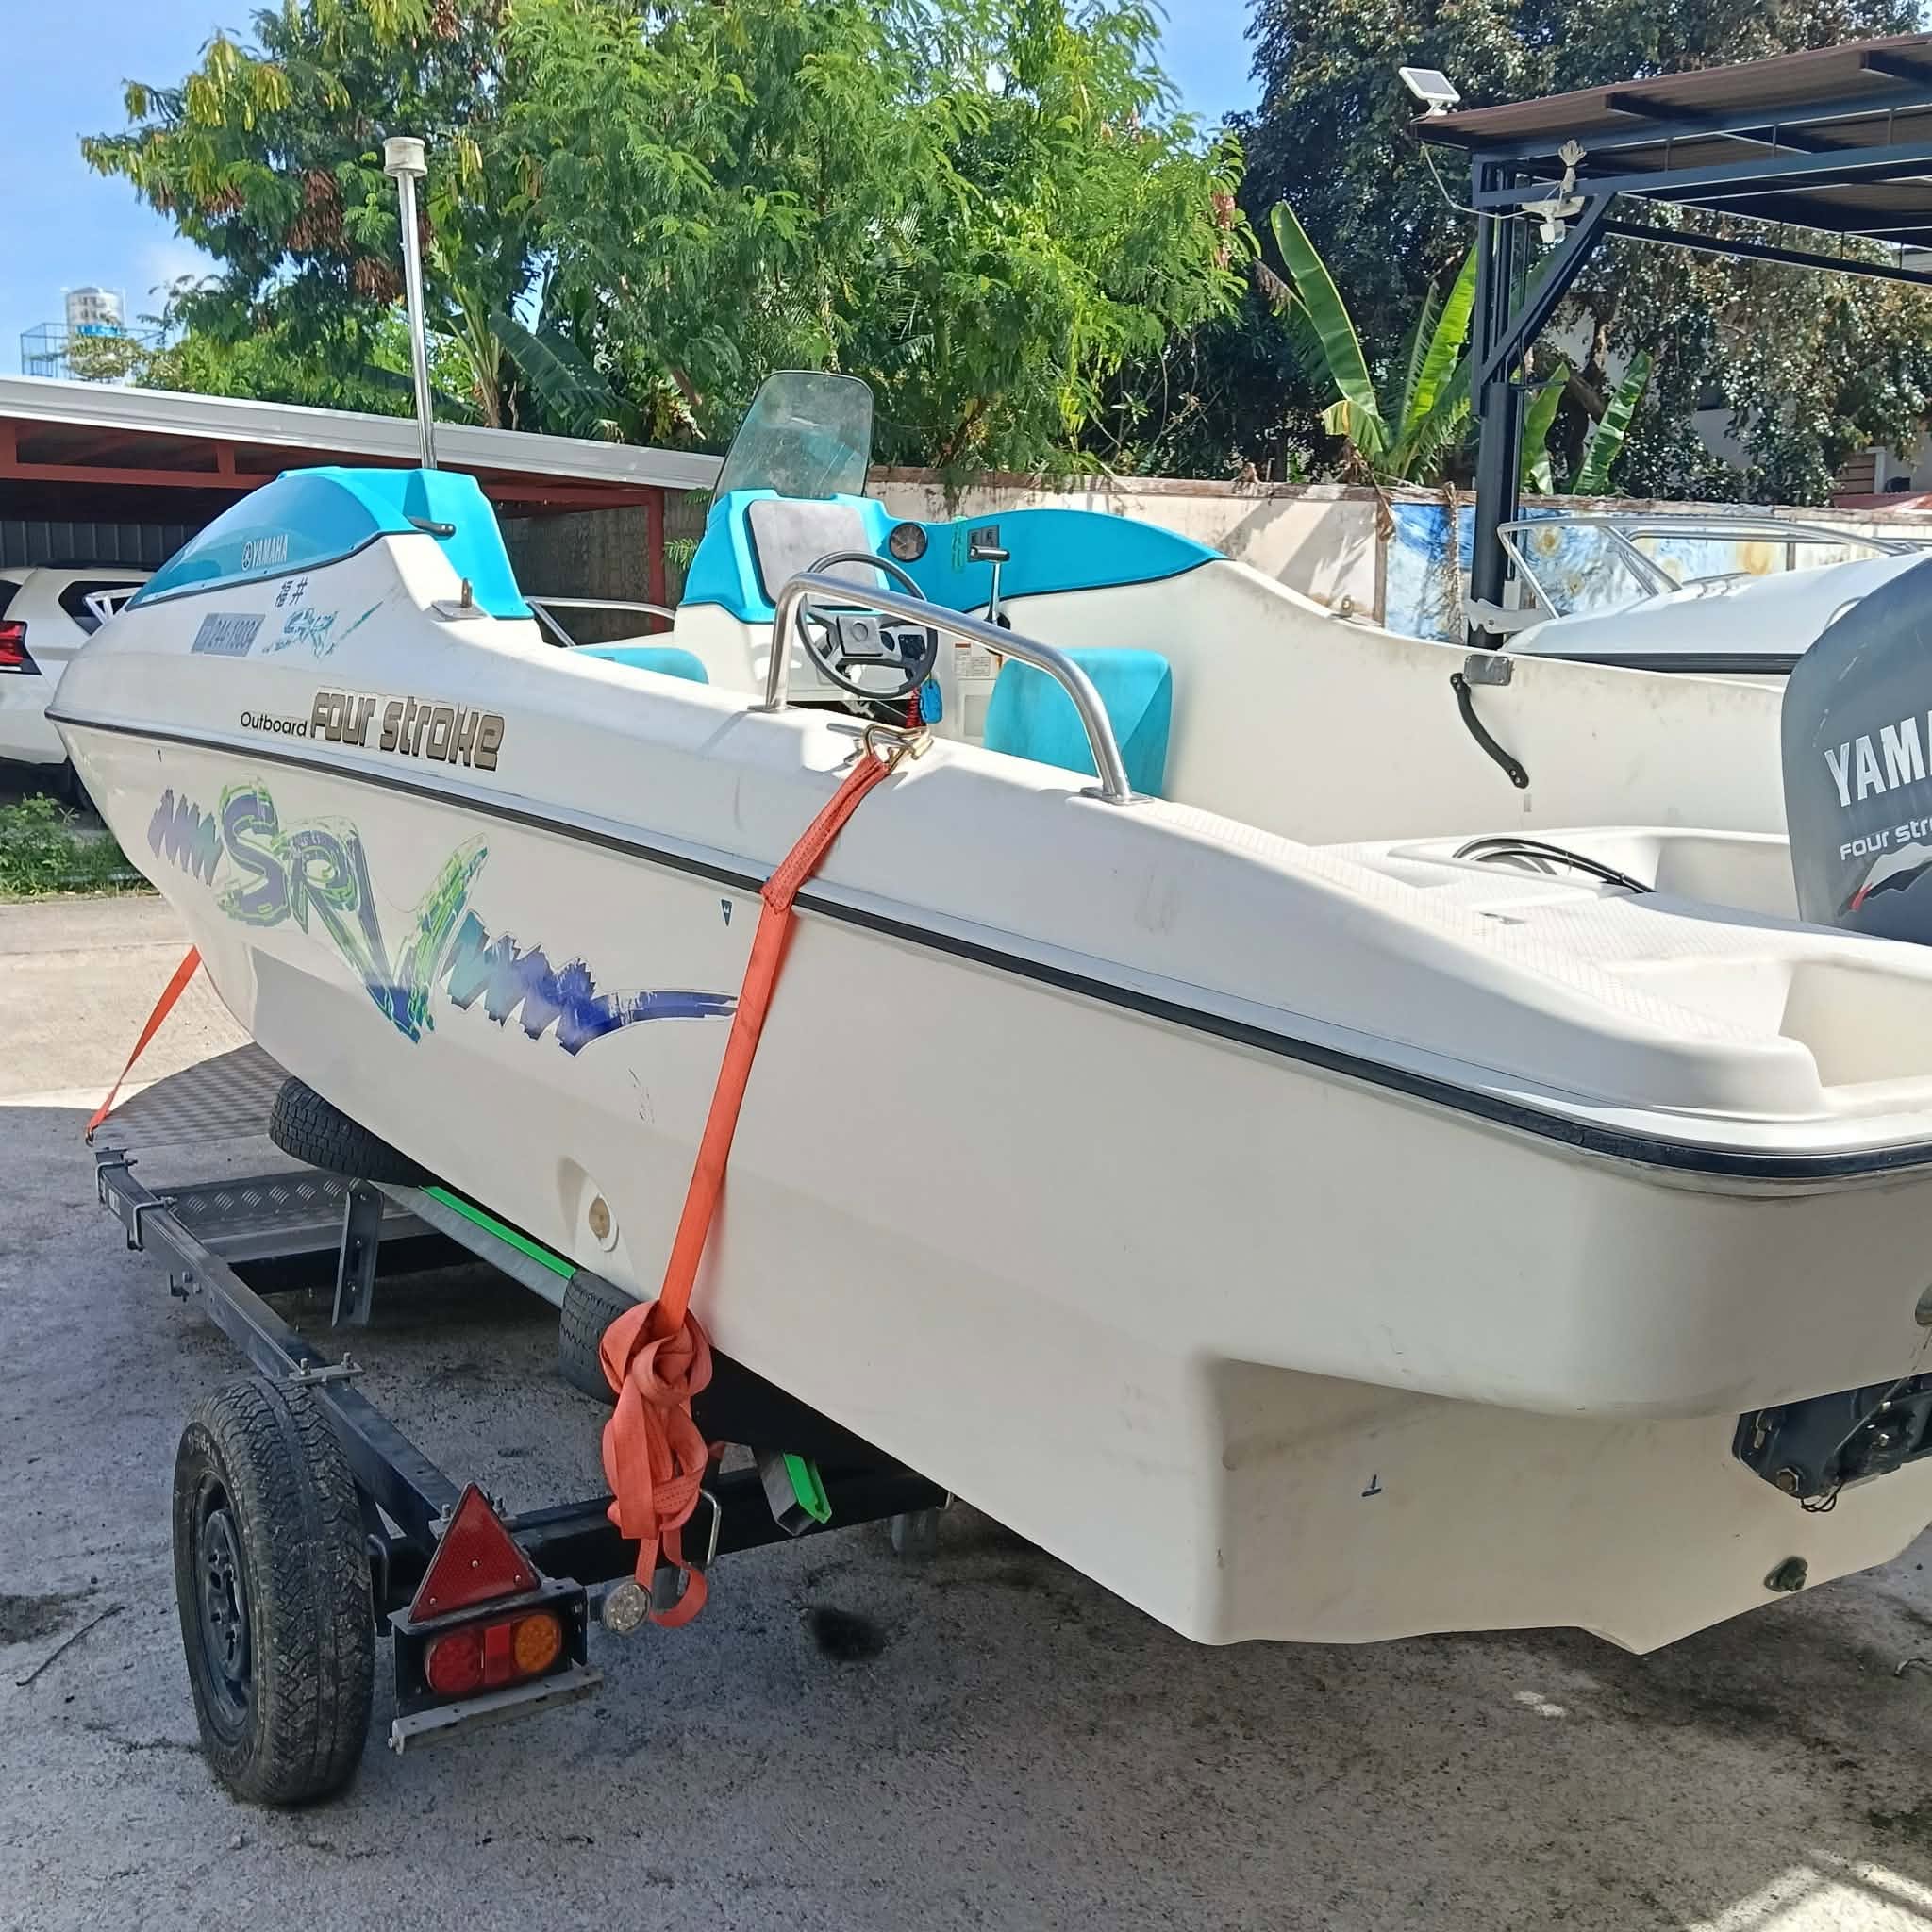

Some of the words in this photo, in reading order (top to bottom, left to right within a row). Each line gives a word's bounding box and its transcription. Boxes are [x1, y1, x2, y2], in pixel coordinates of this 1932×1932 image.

[252, 533, 288, 568] YAMAHA
[240, 711, 308, 737] Outboard
[1824, 709, 1932, 808] YAM
[1894, 818, 1932, 843] str
